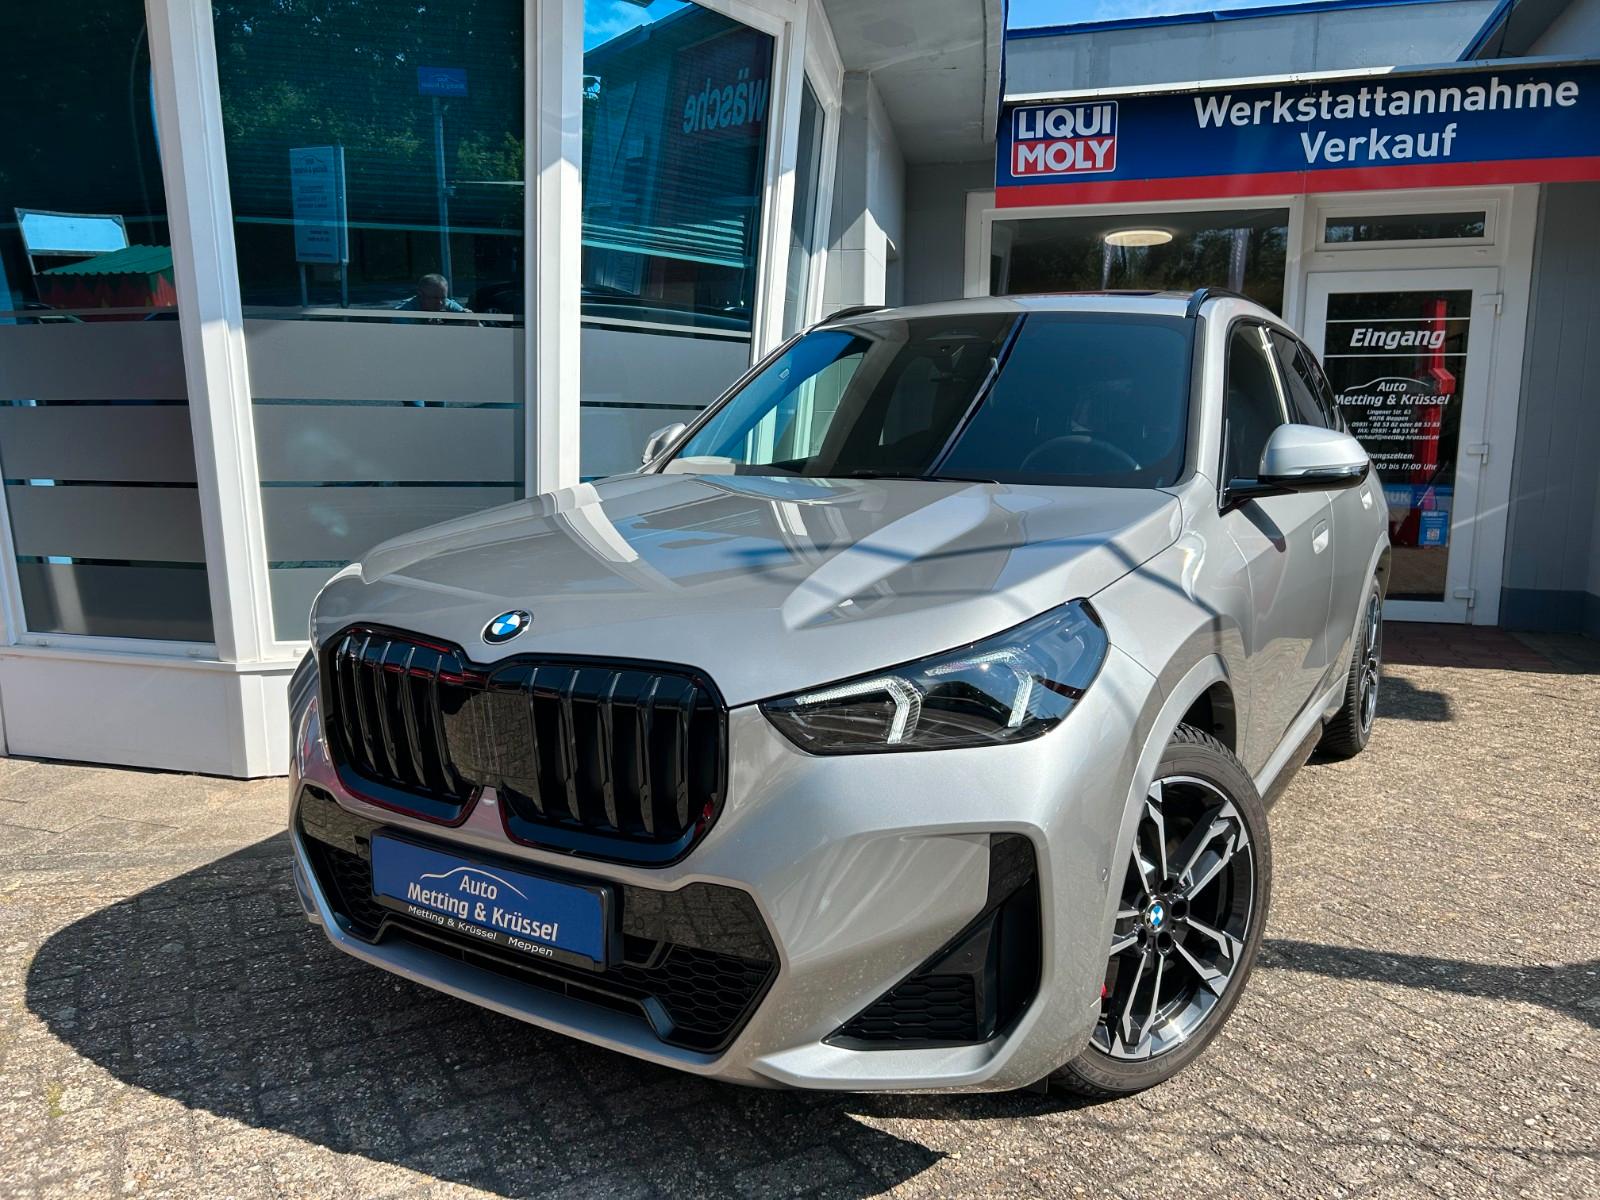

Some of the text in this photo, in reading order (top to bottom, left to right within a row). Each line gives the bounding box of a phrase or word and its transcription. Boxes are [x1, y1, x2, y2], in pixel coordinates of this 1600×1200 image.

[1194, 78, 1580, 129] Werkstattannahme
[1017, 107, 1112, 139] LIQUI
[1016, 139, 1114, 173] MOLY
[1301, 123, 1457, 164] Verkauf
[1350, 328, 1446, 349] Eingang
[1334, 394, 1450, 407] Metting & Krüssel
[1376, 381, 1407, 392] Auto
[1388, 462, 1400, 470] bis
[459, 874, 498, 900] Auto
[407, 882, 559, 942] Metting & Krüssel
[407, 905, 554, 957] Metting & Krüssel Meppen
